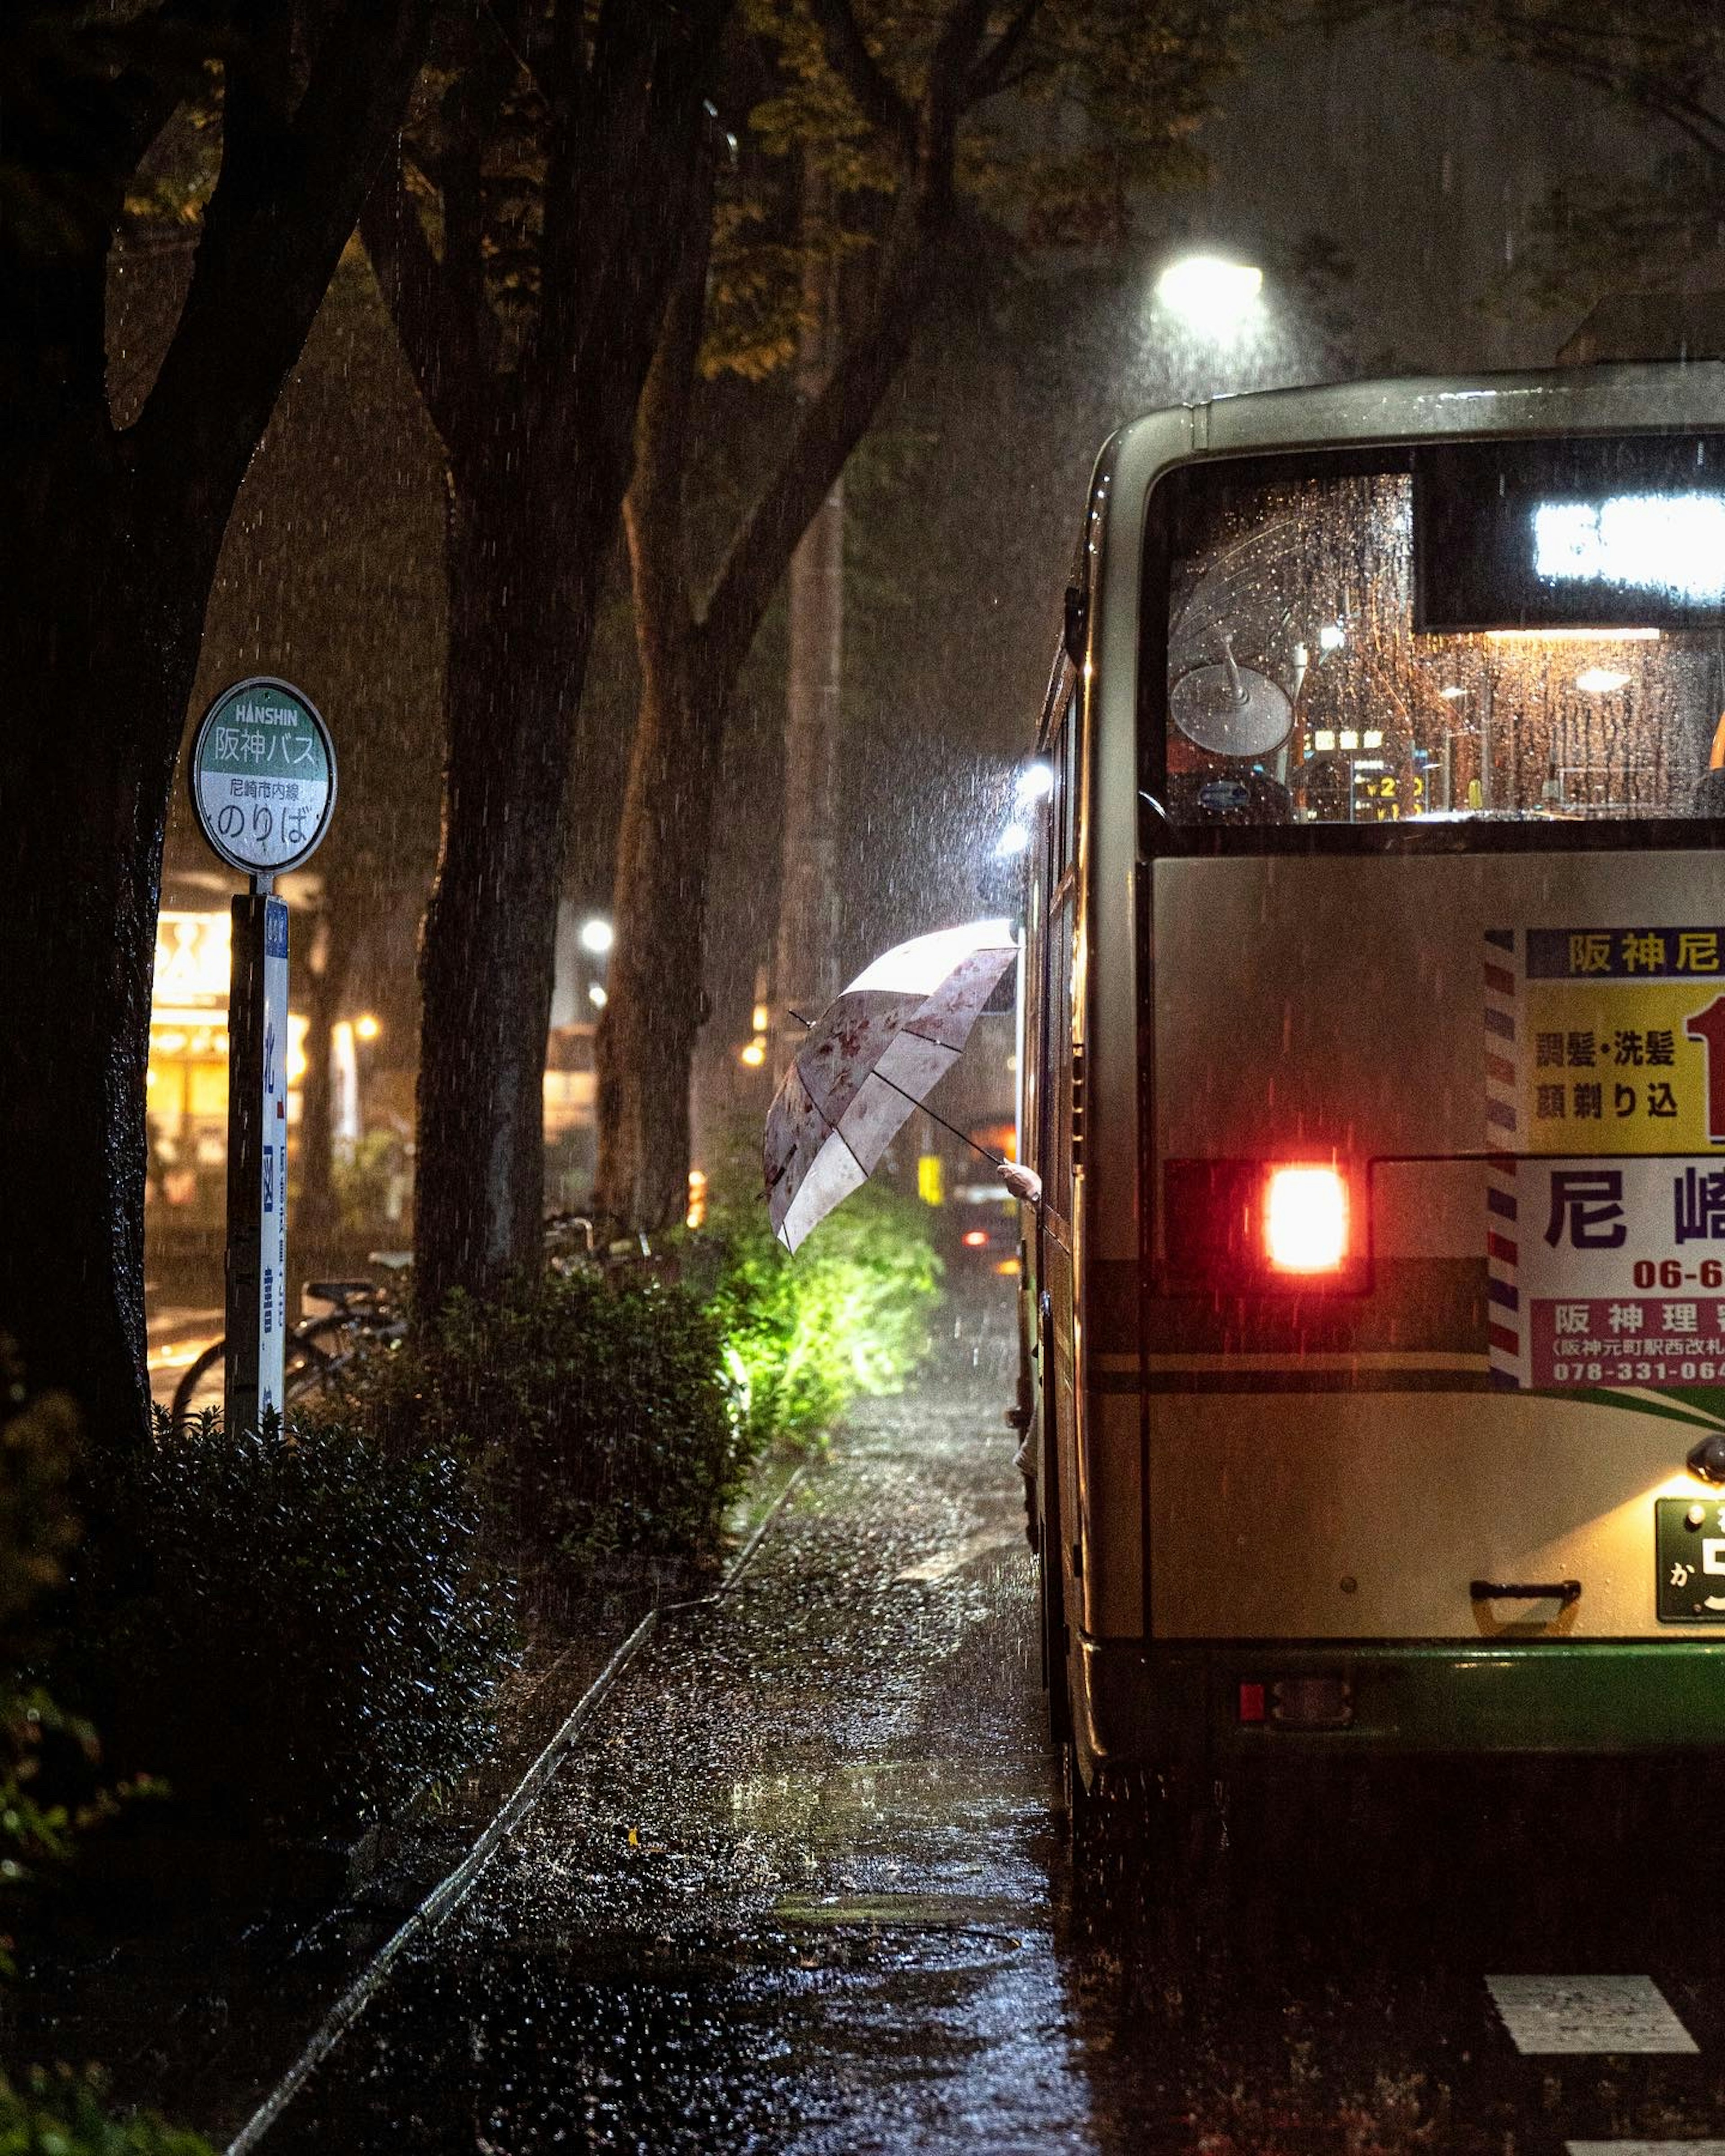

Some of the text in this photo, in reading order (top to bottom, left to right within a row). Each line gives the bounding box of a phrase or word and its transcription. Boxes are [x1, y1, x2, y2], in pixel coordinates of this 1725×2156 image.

[236, 702, 298, 726] HANSHIN
[215, 727, 315, 764] 阪神バス
[230, 779, 300, 801] 尼崎市内線
[218, 804, 312, 844] のりば
[1633, 1259, 1723, 1289] 06-6
[1670, 1562, 1695, 1588] か
